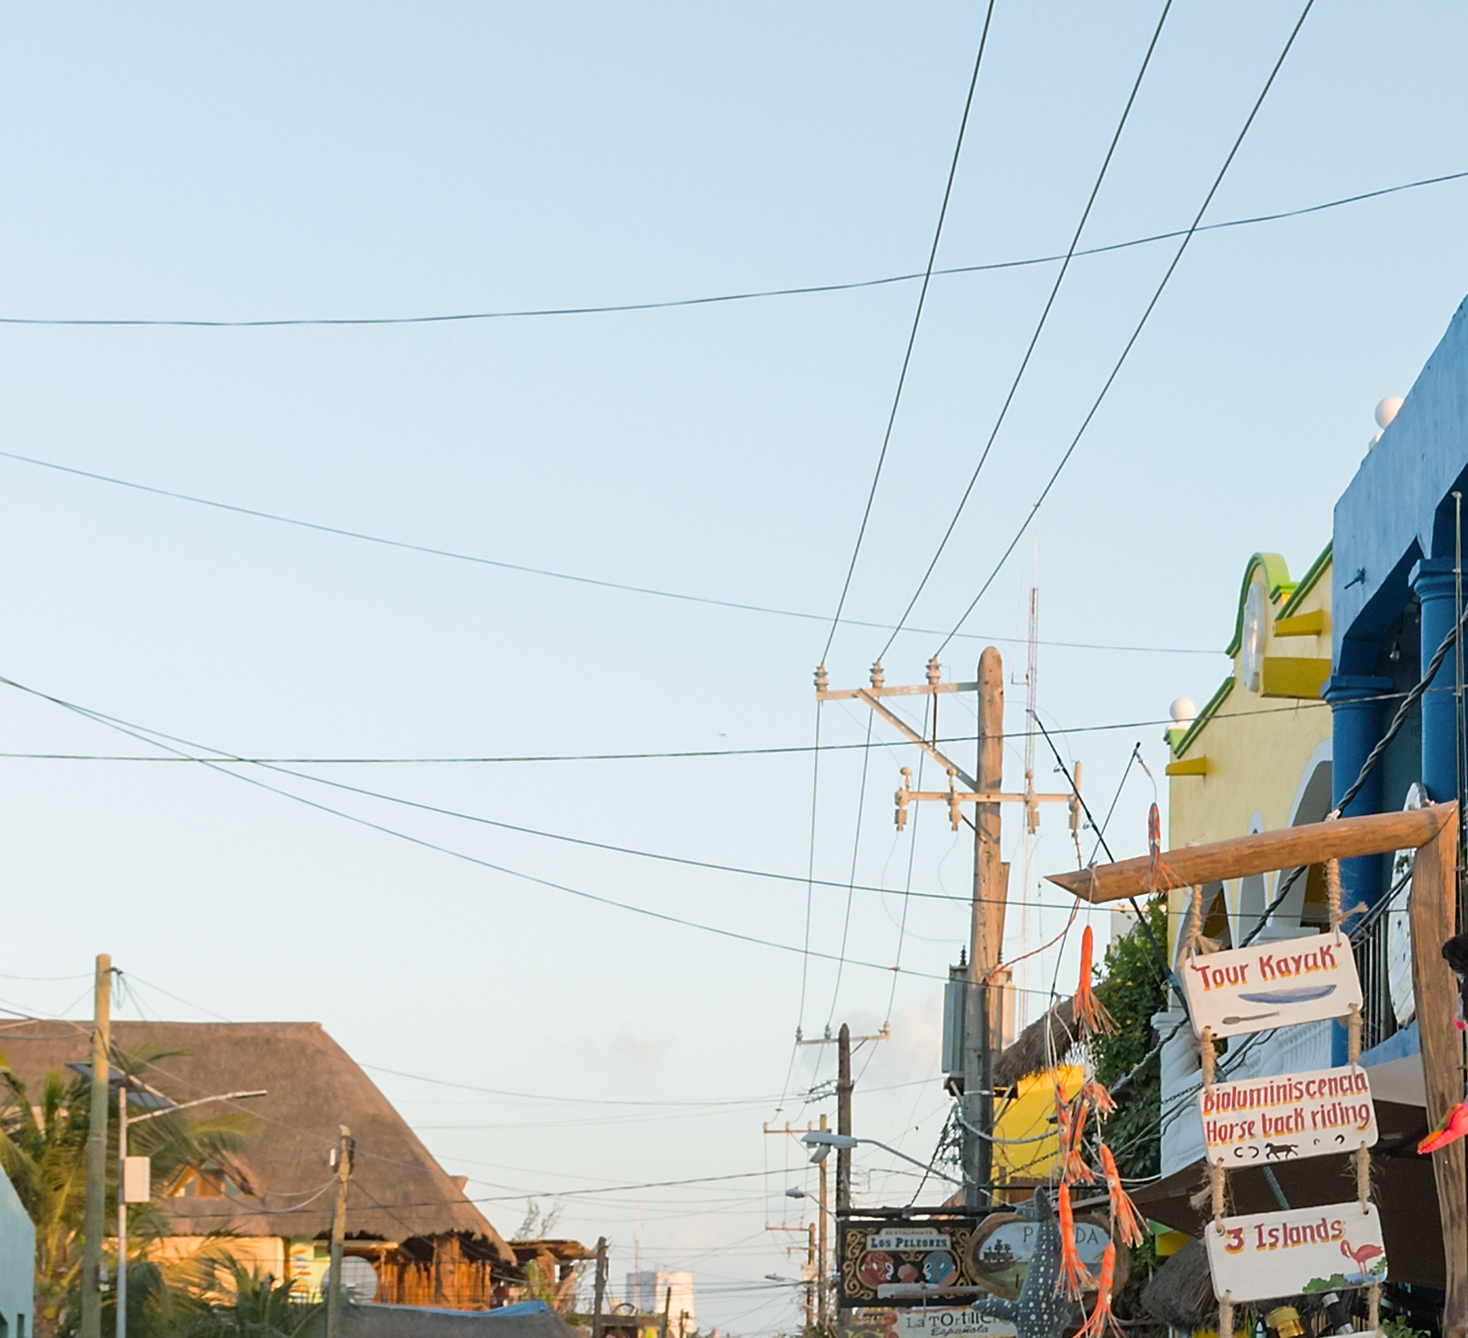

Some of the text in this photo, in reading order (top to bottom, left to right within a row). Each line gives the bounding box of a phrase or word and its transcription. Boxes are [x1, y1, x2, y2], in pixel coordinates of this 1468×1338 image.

[1195, 962, 1248, 992] Tour
[1203, 1072, 1368, 1116] Bioluminiscencia
[1206, 1102, 1371, 1147] Horse back riding
[1224, 1218, 1346, 1254] 3 Islands
[906, 1317, 925, 1328] La
